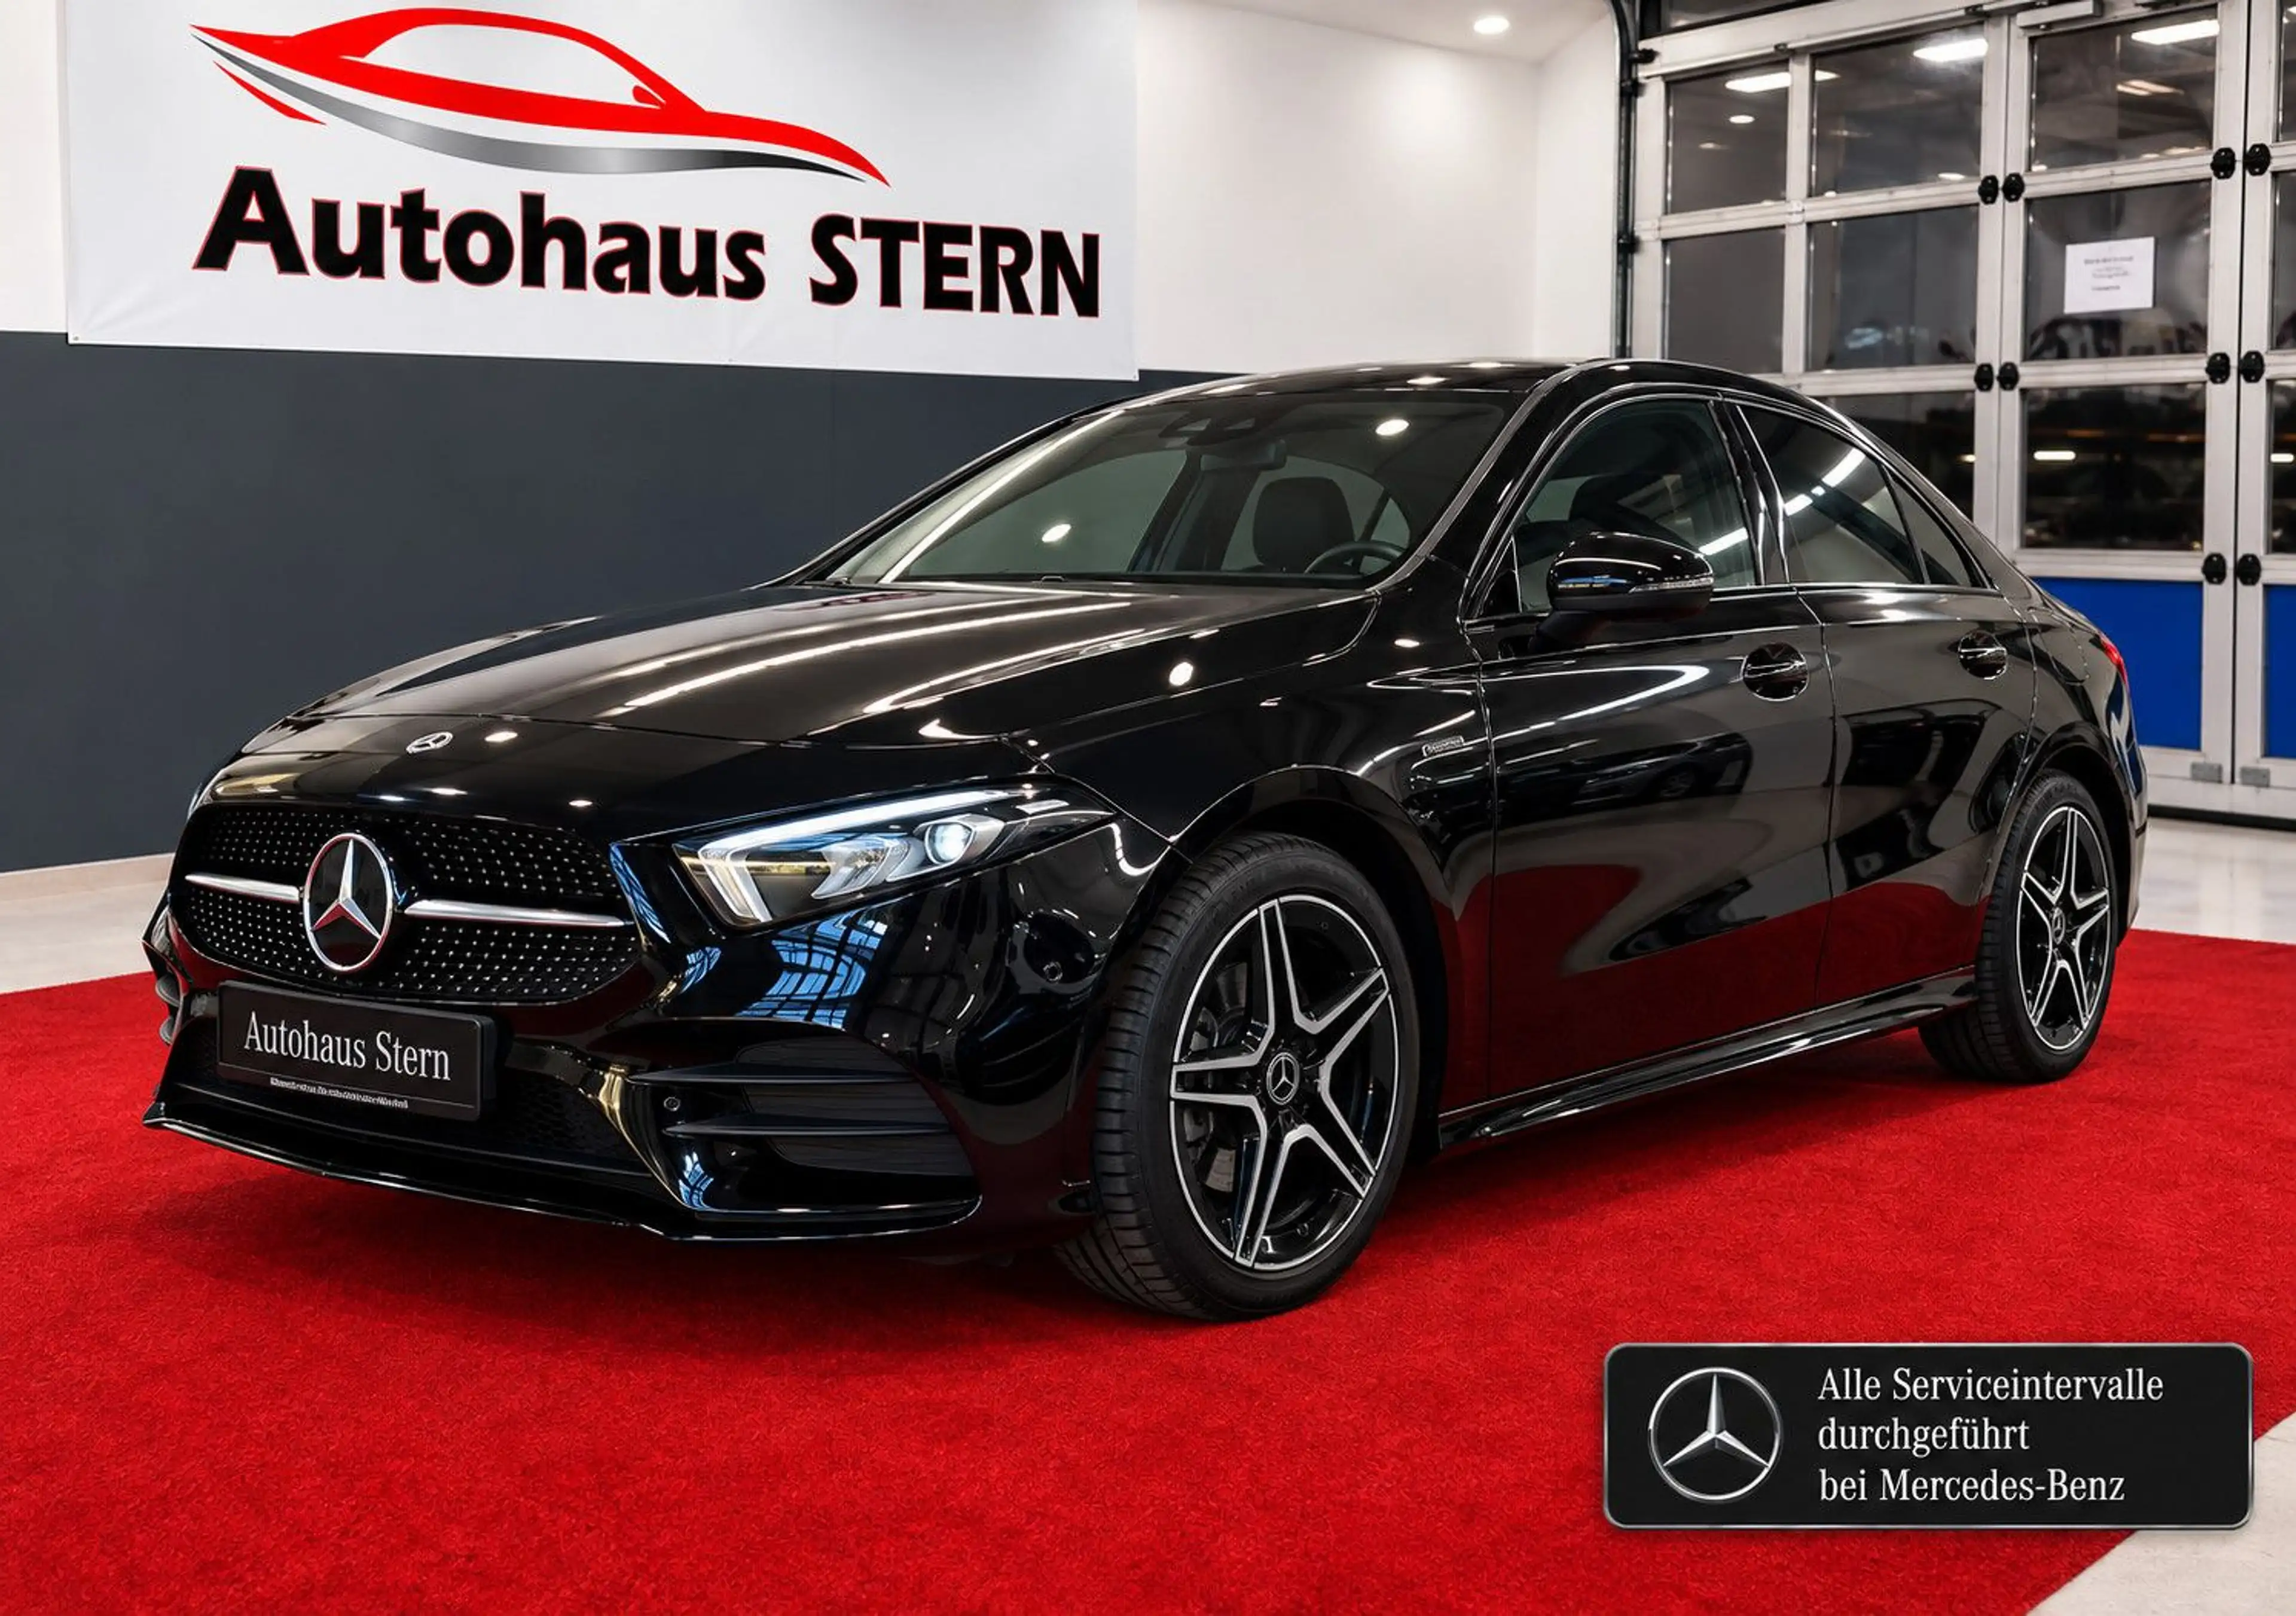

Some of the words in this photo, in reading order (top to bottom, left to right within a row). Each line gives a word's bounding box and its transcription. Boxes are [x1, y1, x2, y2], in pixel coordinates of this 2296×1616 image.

[192, 166, 767, 301] Autohaus
[809, 213, 1100, 319] STERN
[244, 1011, 366, 1068] Autohaus
[375, 1030, 451, 1081] Stern
